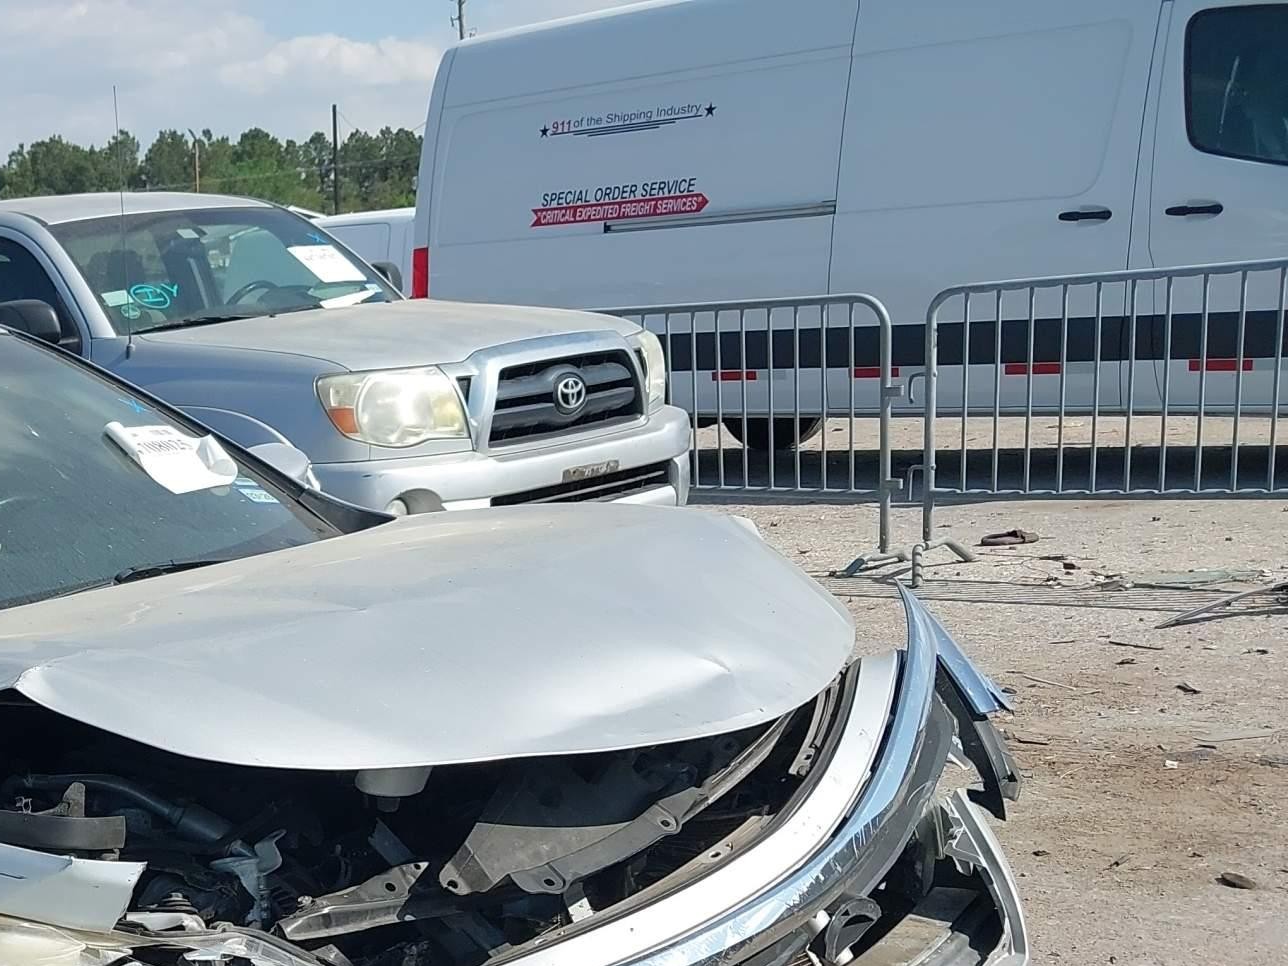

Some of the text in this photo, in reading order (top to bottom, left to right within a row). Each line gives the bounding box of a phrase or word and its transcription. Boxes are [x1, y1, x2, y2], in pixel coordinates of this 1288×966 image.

[551, 103, 702, 133] 911 of the Shipping Industry
[541, 177, 697, 207] SPECIAL ORDER SERVICE
[575, 204, 620, 221] EXPEDITED
[619, 200, 657, 217] FREIGHT
